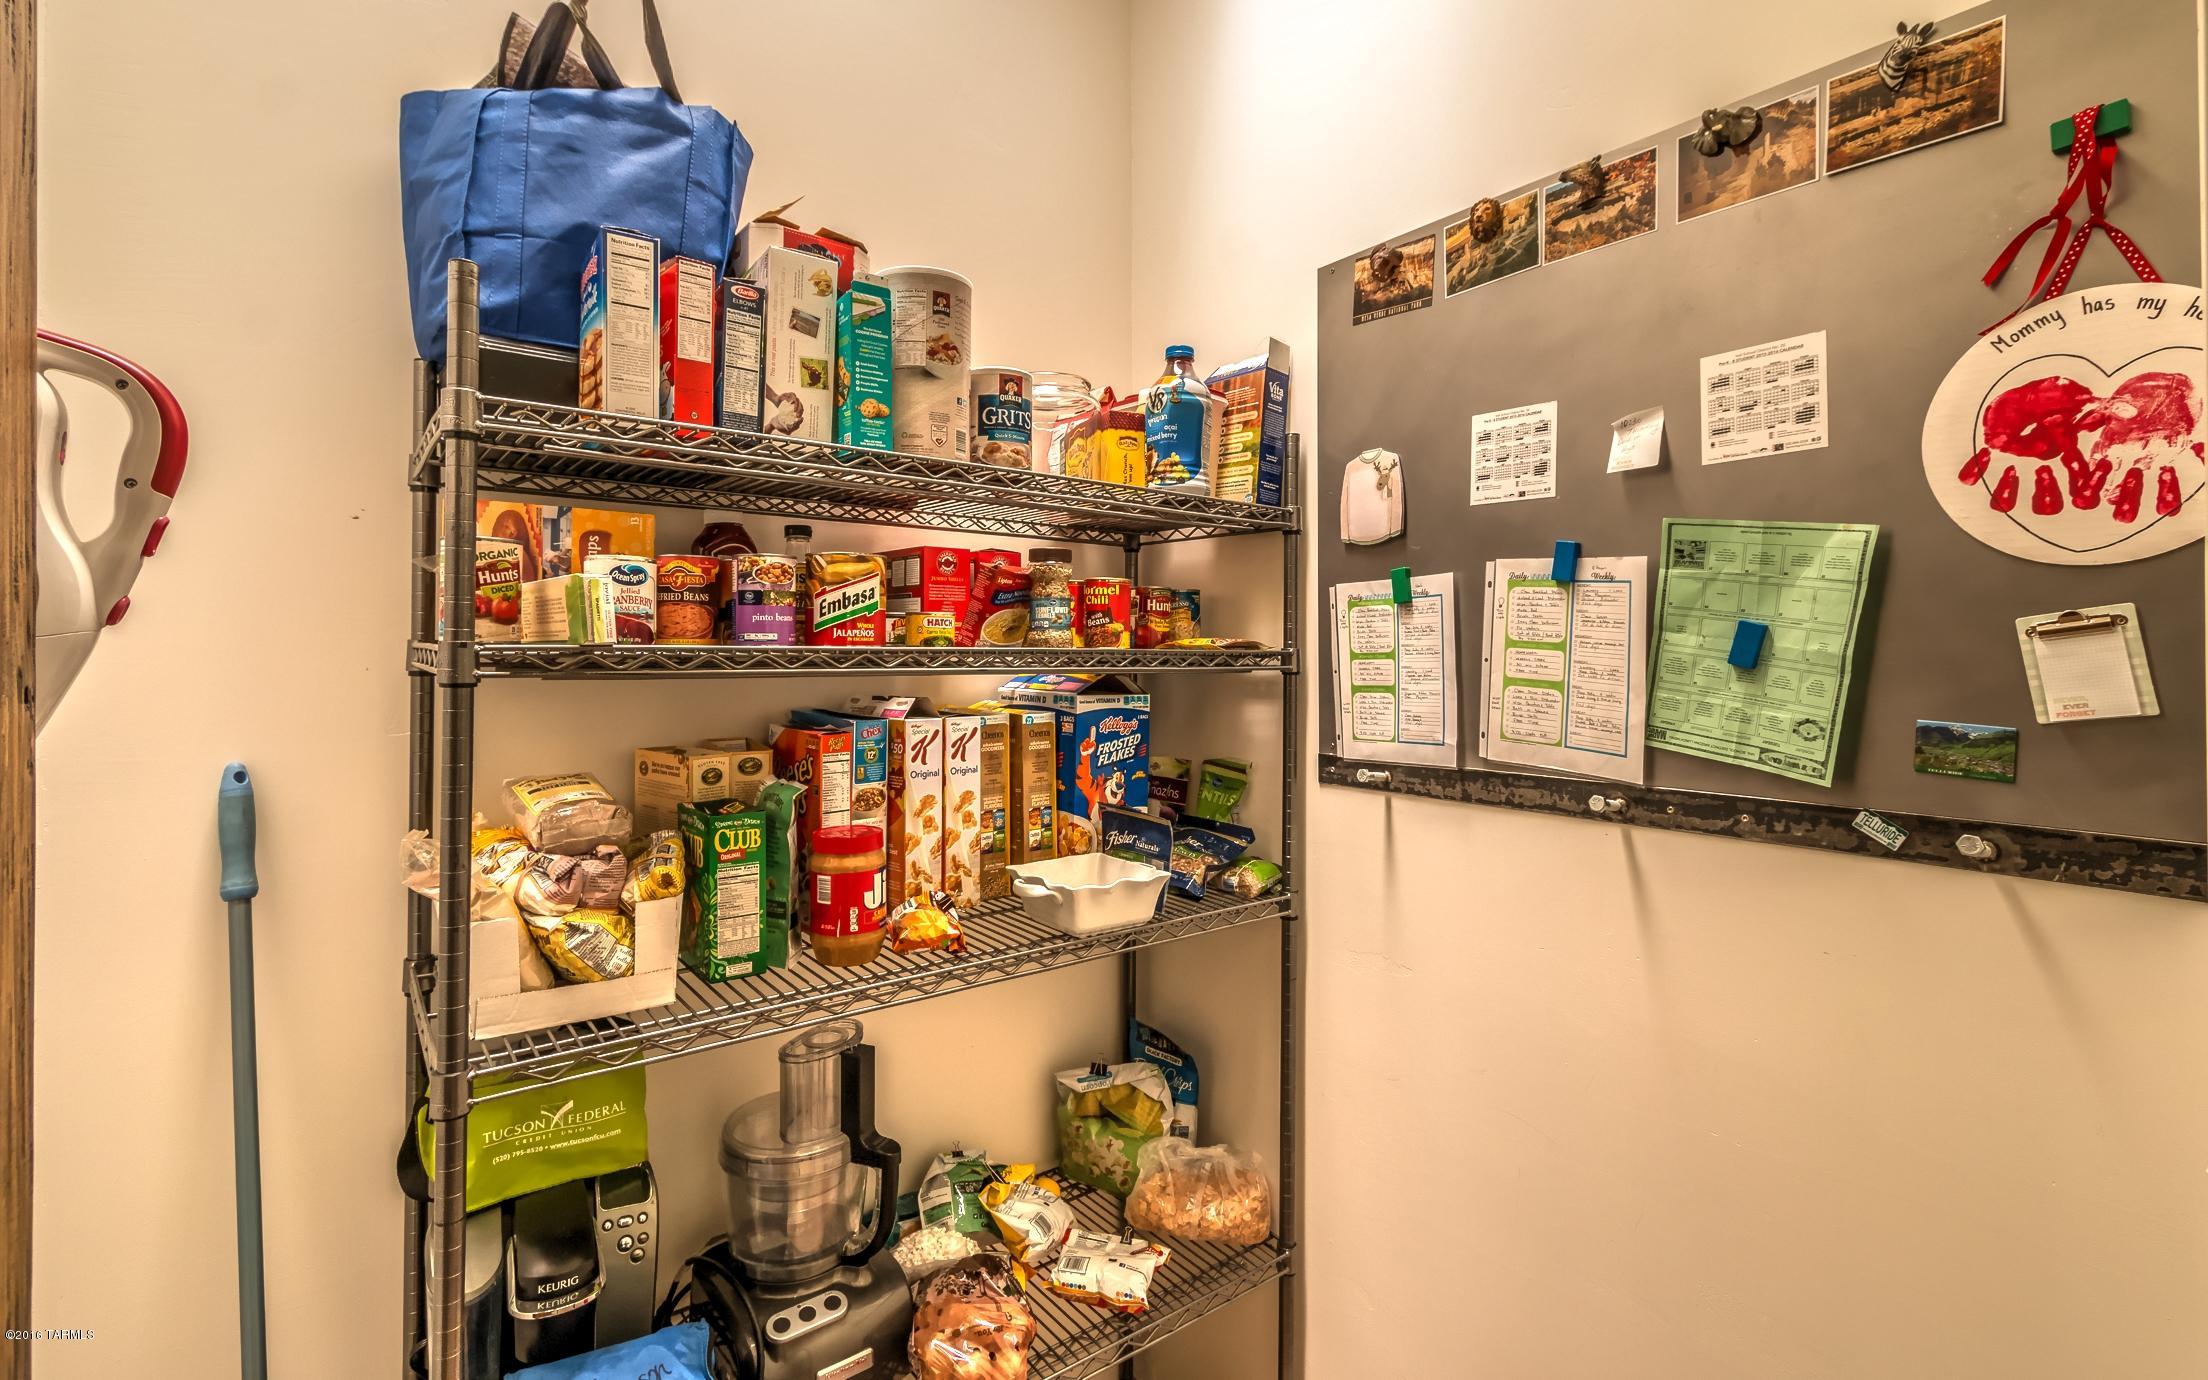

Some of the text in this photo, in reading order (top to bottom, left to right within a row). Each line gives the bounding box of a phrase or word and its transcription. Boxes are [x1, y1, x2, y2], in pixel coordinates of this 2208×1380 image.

[611, 237, 650, 251] Nutrition Facts
[737, 287, 757, 299] Barilla
[732, 298, 757, 309] ELBOWS
[1990, 310, 2067, 353] Mommy
[2081, 296, 2116, 315] has
[2137, 296, 2168, 320] my
[1269, 381, 1284, 397] Vita
[1000, 393, 1022, 403] QUAKER
[1149, 387, 1164, 412] V8
[982, 406, 1032, 430] GRITS
[1161, 432, 1177, 441] berry
[612, 570, 645, 583] Ocean Spray
[491, 583, 514, 595] DICED
[613, 594, 653, 609] ANBERRY
[819, 585, 876, 619] Embasa
[1086, 594, 1109, 605] Chili
[752, 612, 794, 622] pinto beans
[927, 618, 953, 627] HATCH
[1087, 616, 1110, 628] Beans
[833, 627, 875, 639] JALAPEÑOS
[1018, 694, 1041, 703] VITAMIN
[1042, 695, 1047, 704] D
[2056, 710, 2096, 718] FORGET
[951, 726, 970, 734] Special
[1100, 716, 1139, 734] Kellogg's
[861, 726, 882, 738] Chex
[911, 728, 931, 736] Special
[911, 729, 939, 765] K
[950, 727, 978, 762] K
[1097, 733, 1142, 756] FROSTED
[1097, 746, 1136, 766] FLAKES
[910, 768, 940, 780] Original
[950, 766, 979, 777] Original
[1860, 813, 1903, 845] TELLURIDE
[714, 828, 762, 853] CLUB
[1106, 830, 1138, 851] Fisher
[1135, 840, 1160, 853] Naturals
[720, 852, 741, 860] ORIGINAL
[1161, 1051, 1181, 1066] FACTORY
[483, 1100, 627, 1144] TUCSON FEDERAL
[515, 1125, 593, 1146] CREDIT UNION
[492, 1128, 622, 1165] (520) 795-8520 www.tucsonfcu.com
[537, 1275, 579, 1295] KEURIG
